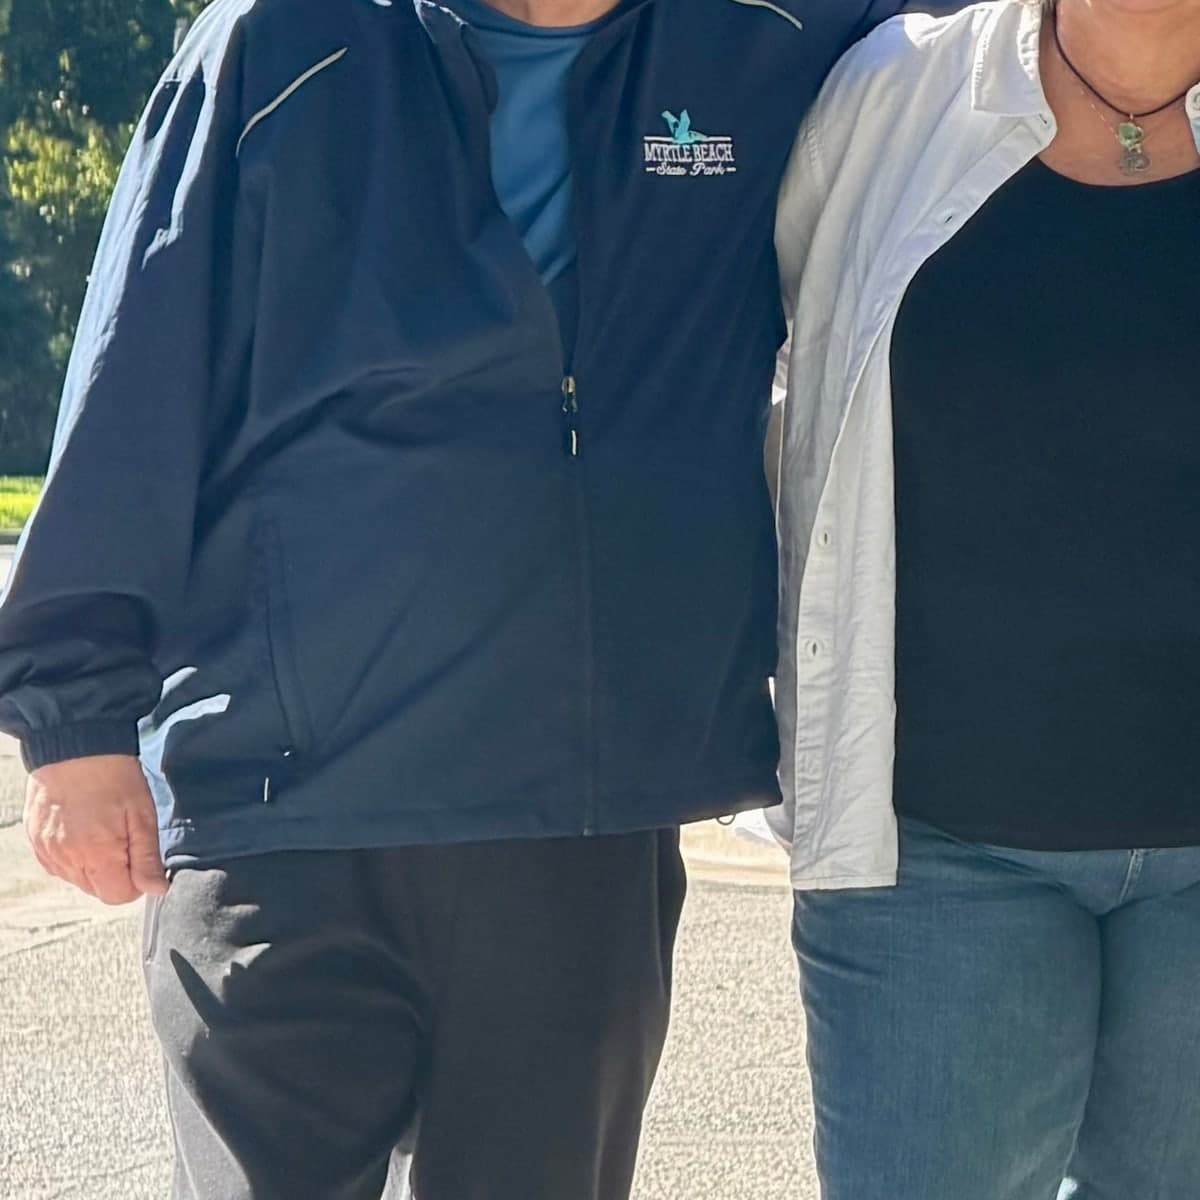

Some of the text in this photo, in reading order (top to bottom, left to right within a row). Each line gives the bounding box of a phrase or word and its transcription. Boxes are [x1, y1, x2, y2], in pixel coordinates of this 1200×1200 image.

[644, 143, 735, 162] MYRTLE BEACH
[656, 161, 726, 176] State Park
